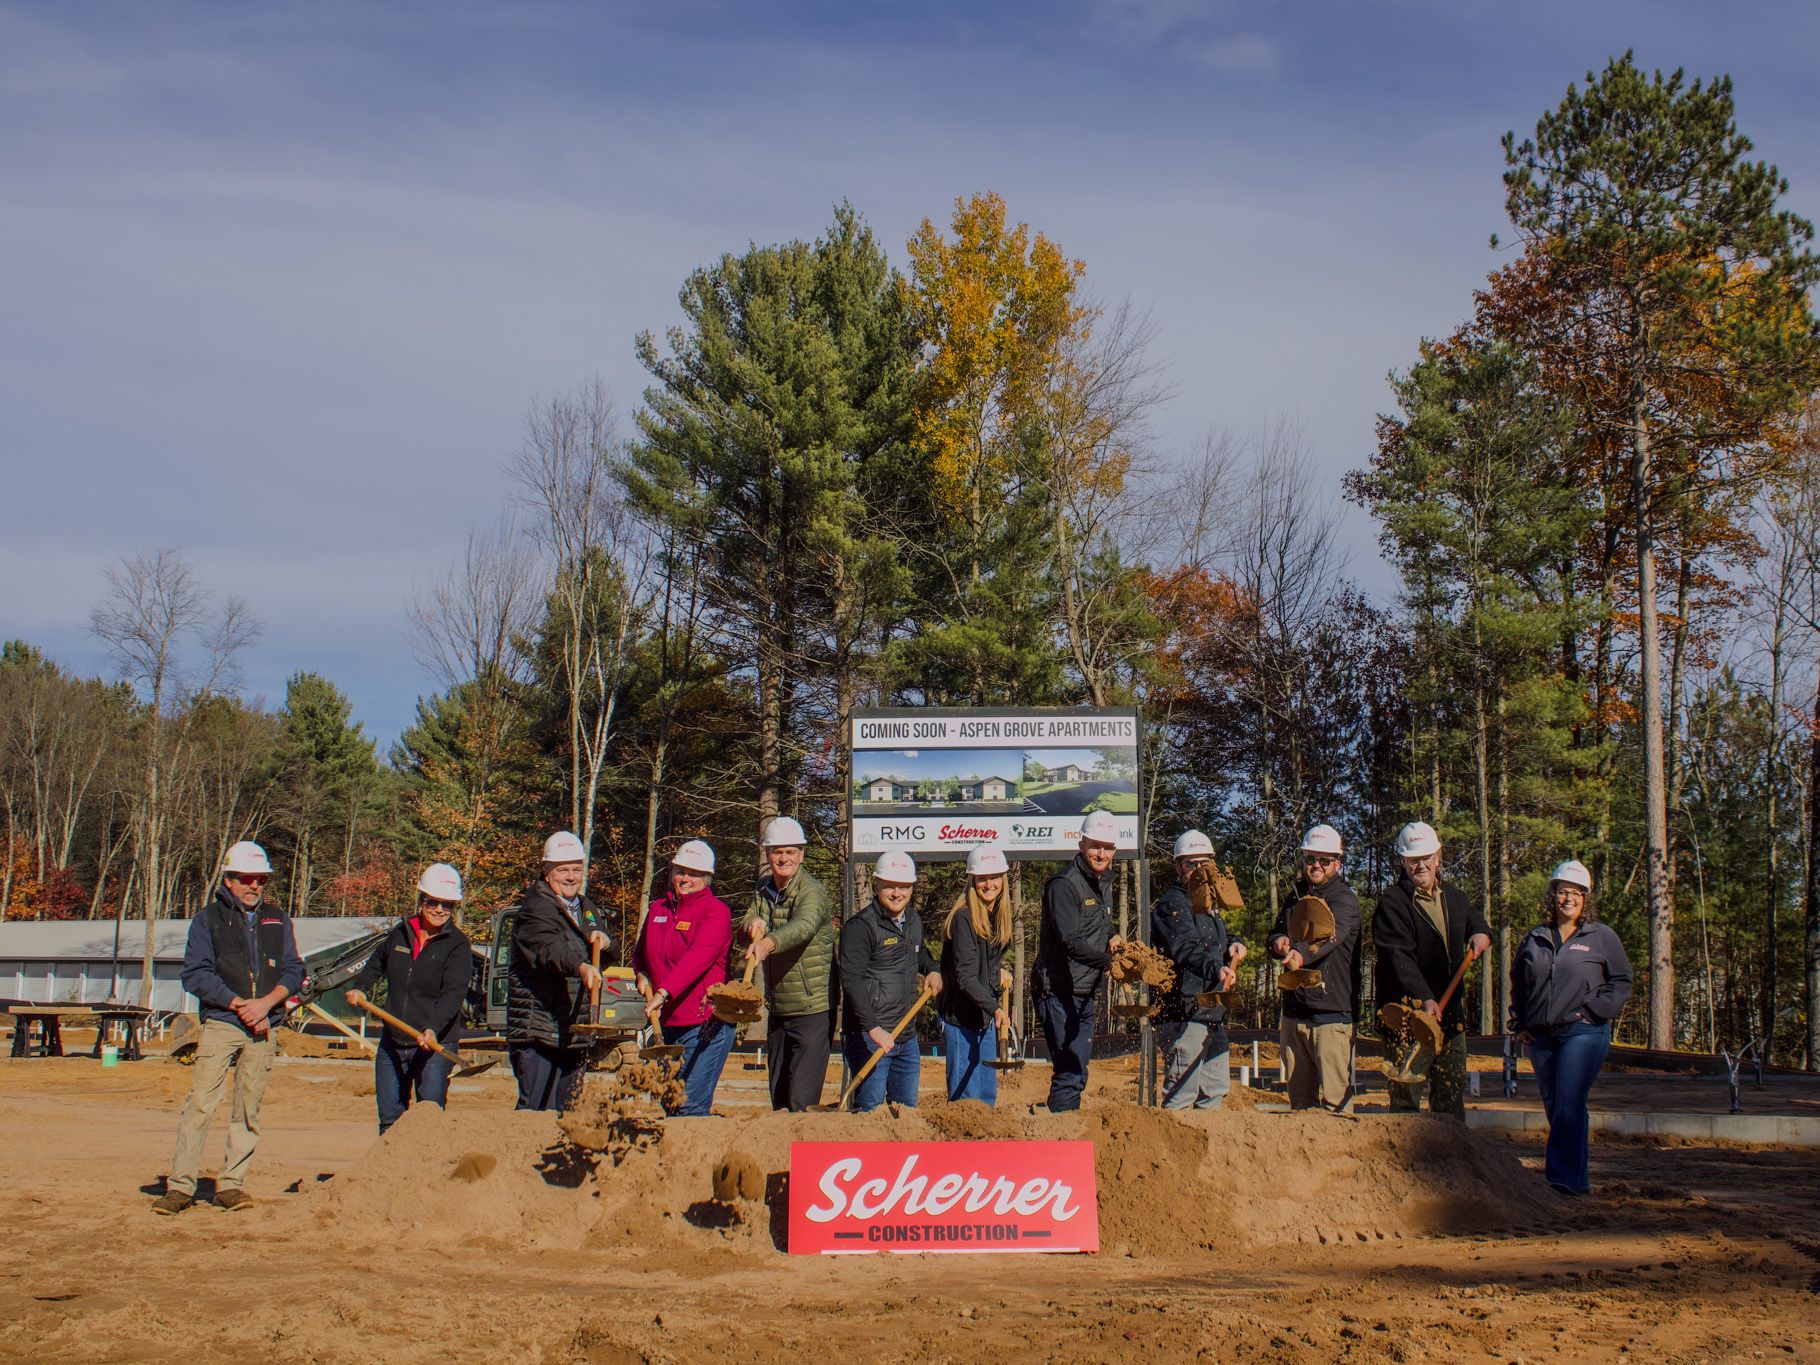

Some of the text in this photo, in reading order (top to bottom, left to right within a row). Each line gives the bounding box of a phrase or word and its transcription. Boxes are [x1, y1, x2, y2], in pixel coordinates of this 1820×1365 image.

[861, 722, 909, 739] COMING
[913, 722, 947, 738] SOON
[960, 722, 1000, 738] ASPEN
[1003, 722, 1045, 737] GROVE
[1048, 721, 1132, 737] APARTMENTS
[881, 825, 925, 840] RMG
[938, 824, 999, 840] Scherrer
[1026, 827, 1054, 838] REI
[805, 1154, 1080, 1223] Scherrer
[868, 1224, 1018, 1242] CONSTRUCTION
